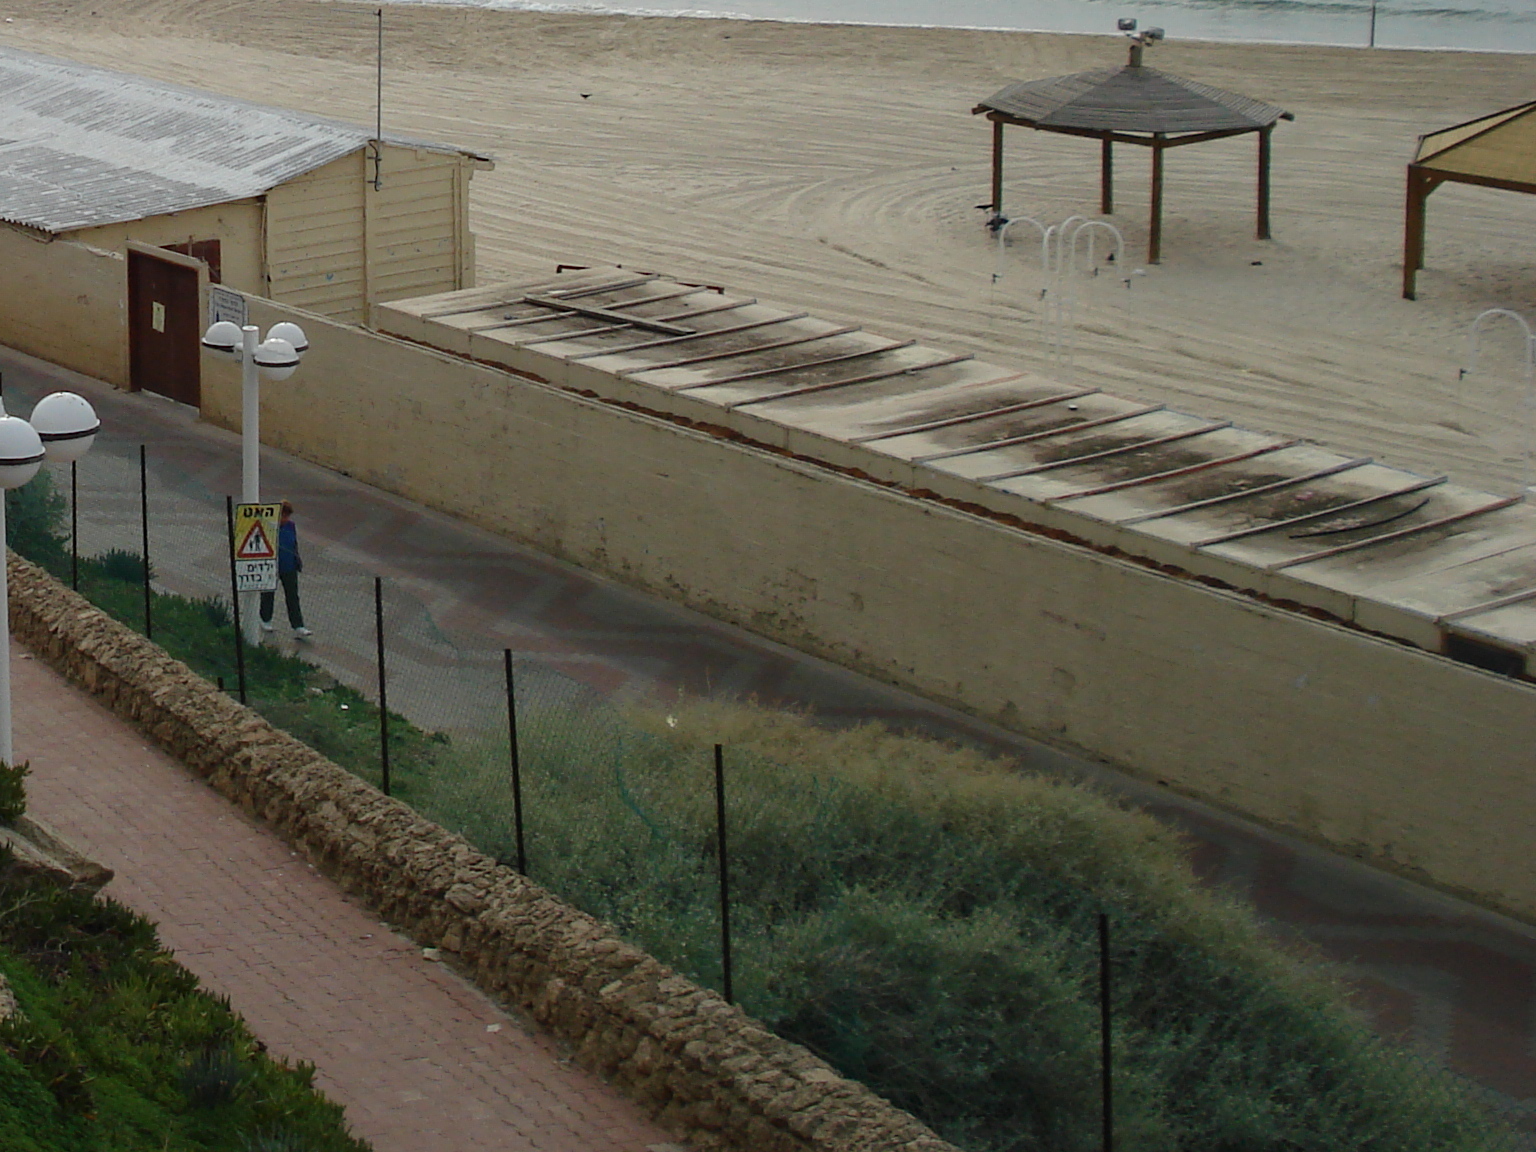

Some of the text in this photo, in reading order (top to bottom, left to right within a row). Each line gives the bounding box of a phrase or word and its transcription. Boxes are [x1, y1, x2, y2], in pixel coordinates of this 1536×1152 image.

[243, 507, 274, 518] האט
[247, 561, 274, 572] ילדים
[238, 574, 262, 588] בדרך
